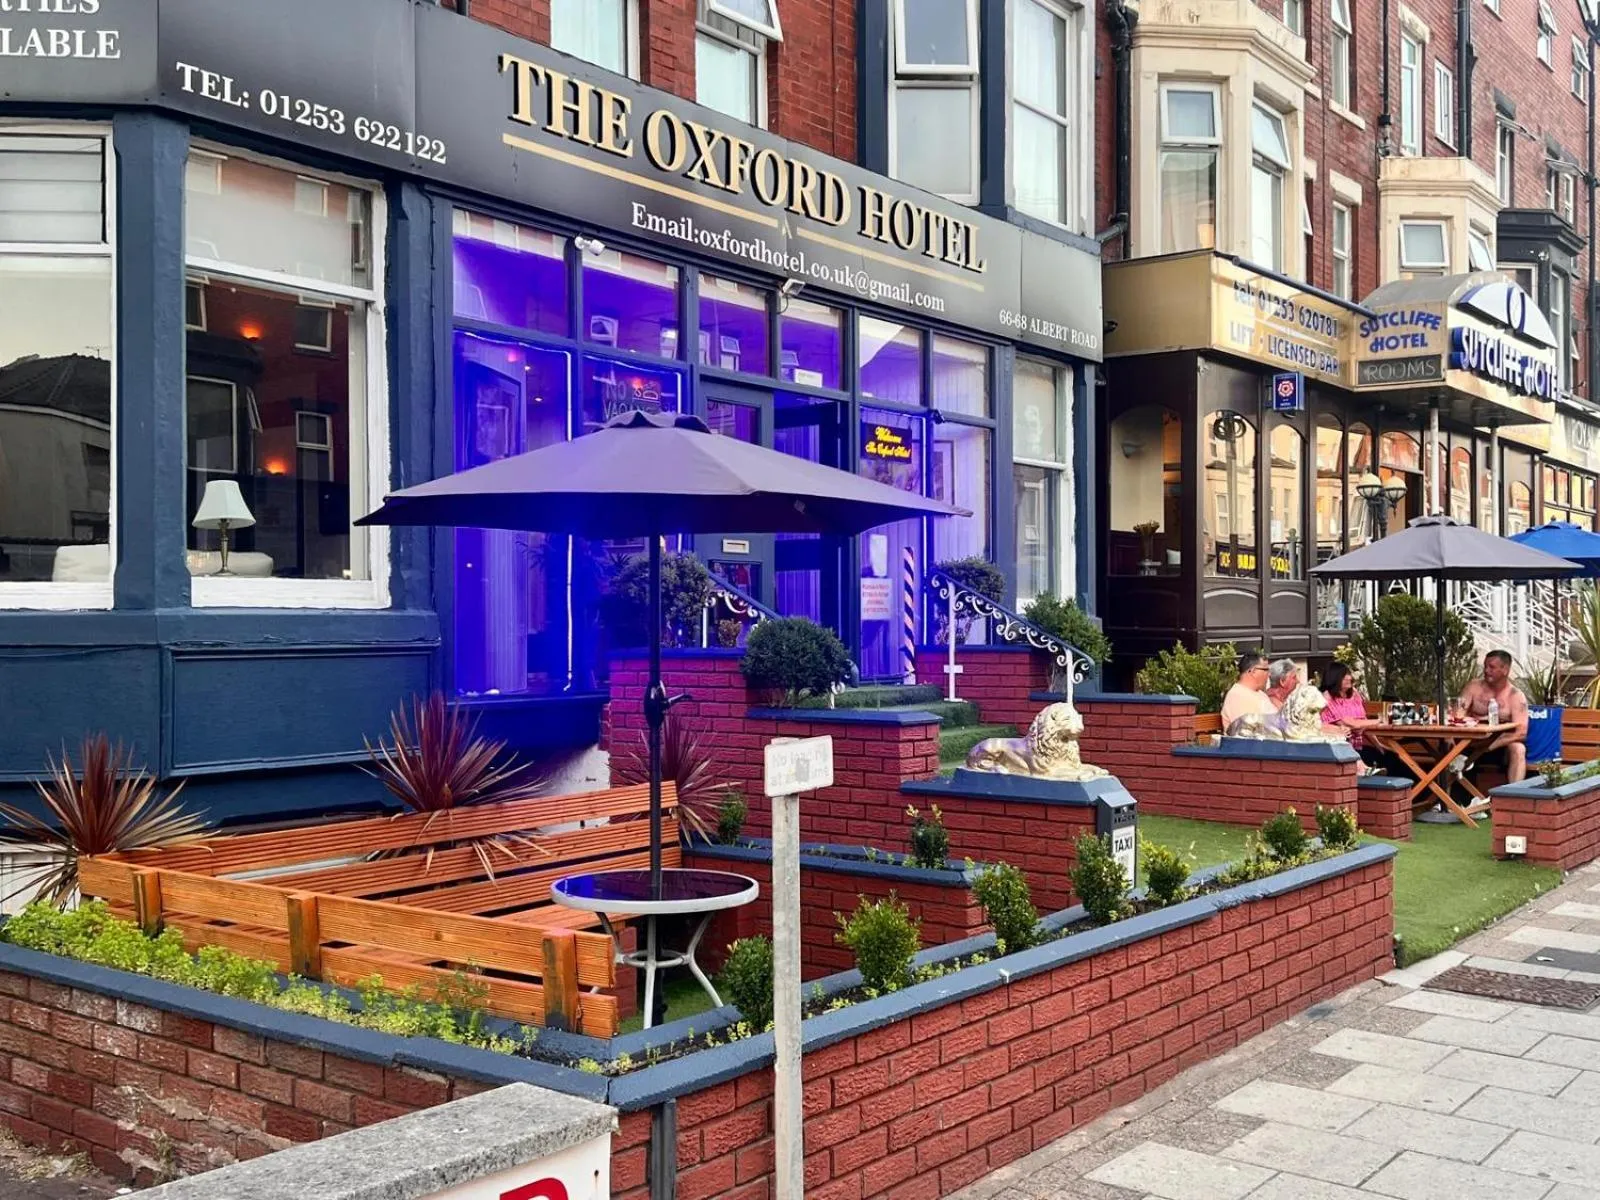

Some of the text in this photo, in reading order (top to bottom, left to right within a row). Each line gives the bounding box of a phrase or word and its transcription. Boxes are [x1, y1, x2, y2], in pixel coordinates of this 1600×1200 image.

[176, 61, 447, 164] TEL: 01253 622122
[499, 53, 988, 274] THE OXFORD HOTEL
[630, 201, 946, 312] Email:oxfordhotel.co.uk@gmail.com
[998, 308, 1098, 349] 66-68 ALBERT ROAD
[1258, 290, 1295, 322] 01253
[1298, 305, 1338, 339] 620781
[1359, 310, 1443, 339] SUTCLIFFE
[1229, 319, 1339, 377] LIFT LICENSED BAR
[1369, 332, 1429, 354] HOTEL
[1459, 326, 1560, 402] SUTCLIFFE HOTE
[1365, 359, 1436, 381] ROOMS
[1114, 836, 1133, 853] TAXI
